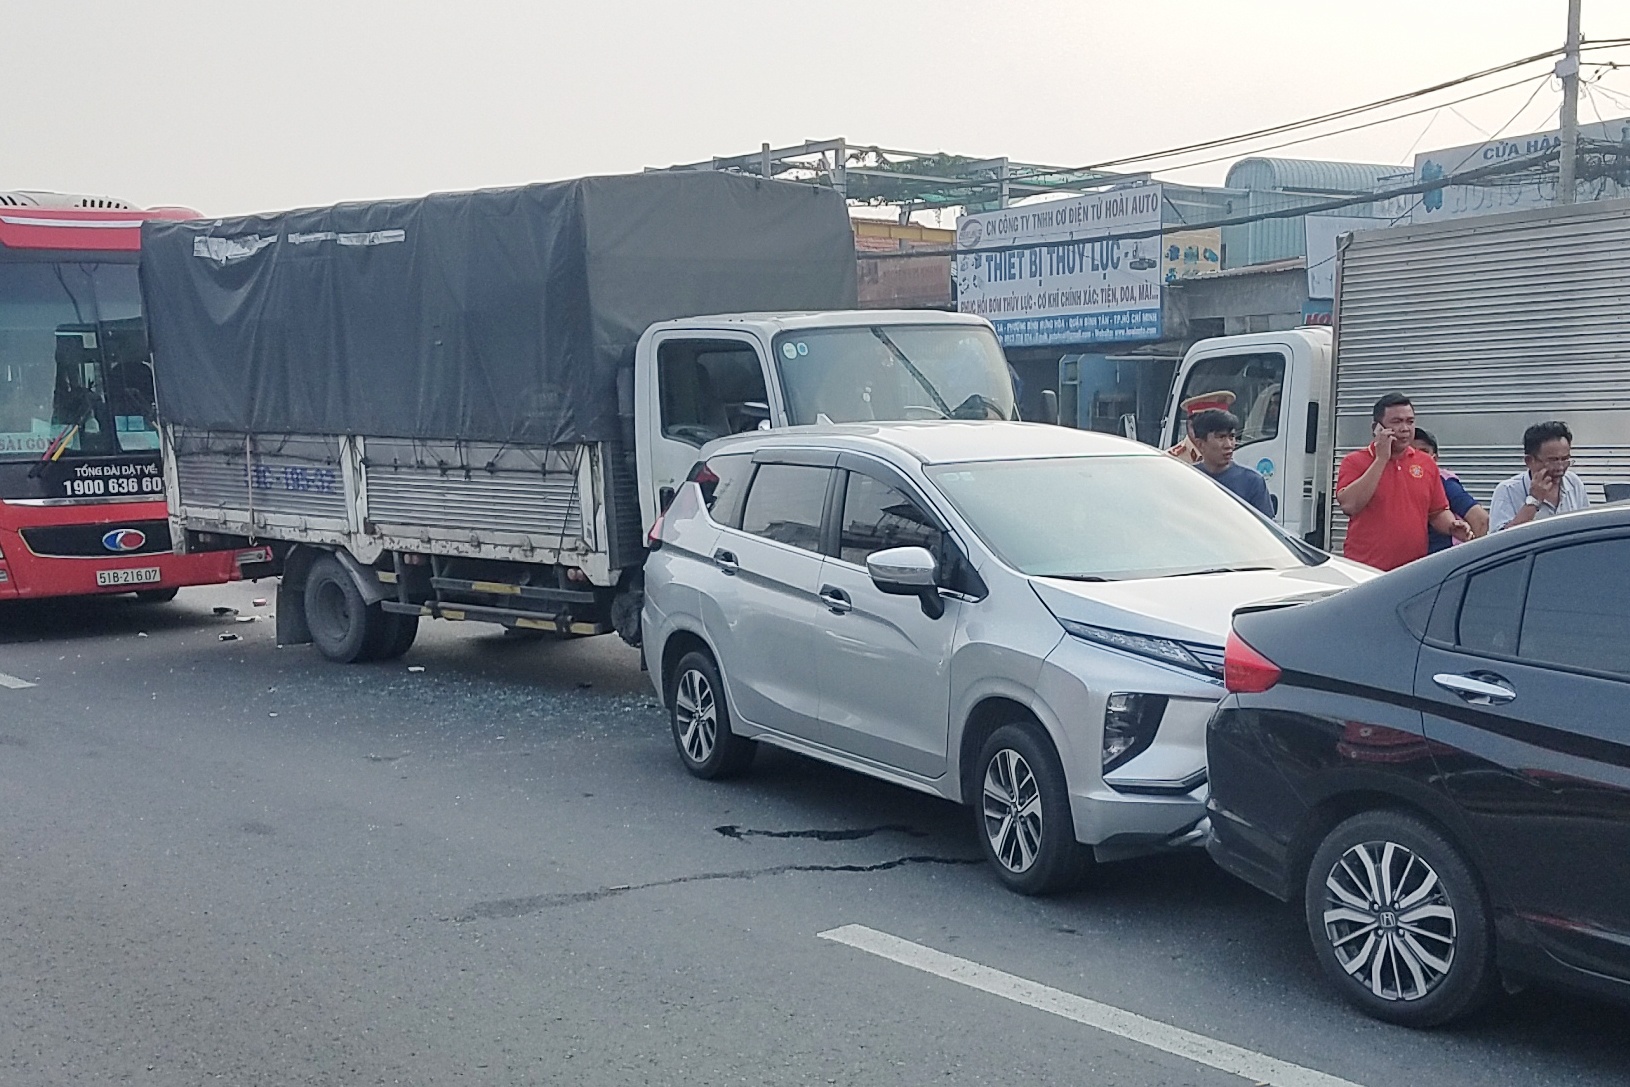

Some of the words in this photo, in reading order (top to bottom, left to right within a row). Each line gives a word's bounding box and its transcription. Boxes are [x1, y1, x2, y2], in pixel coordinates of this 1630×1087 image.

[1482, 139, 1520, 160] CỬA
[986, 220, 996, 236] CN
[998, 214, 1019, 235] CÔNG
[1020, 214, 1030, 232] TY
[1031, 210, 1053, 230] TNHH
[1056, 206, 1067, 226] CƠ
[1069, 202, 1089, 226] ĐIỆN
[1091, 197, 1103, 220] TỬ
[1105, 193, 1128, 219] HOÀI
[1131, 193, 1158, 215] AUTO
[1029, 248, 1043, 287] BỊ
[1037, 292, 1047, 309] CƠ
[1047, 288, 1060, 308] KHÍ
[1060, 287, 1082, 307] CHÍNH
[63, 479, 105, 496] 1900
[108, 477, 138, 494] 636
[142, 476, 165, 492] 60
